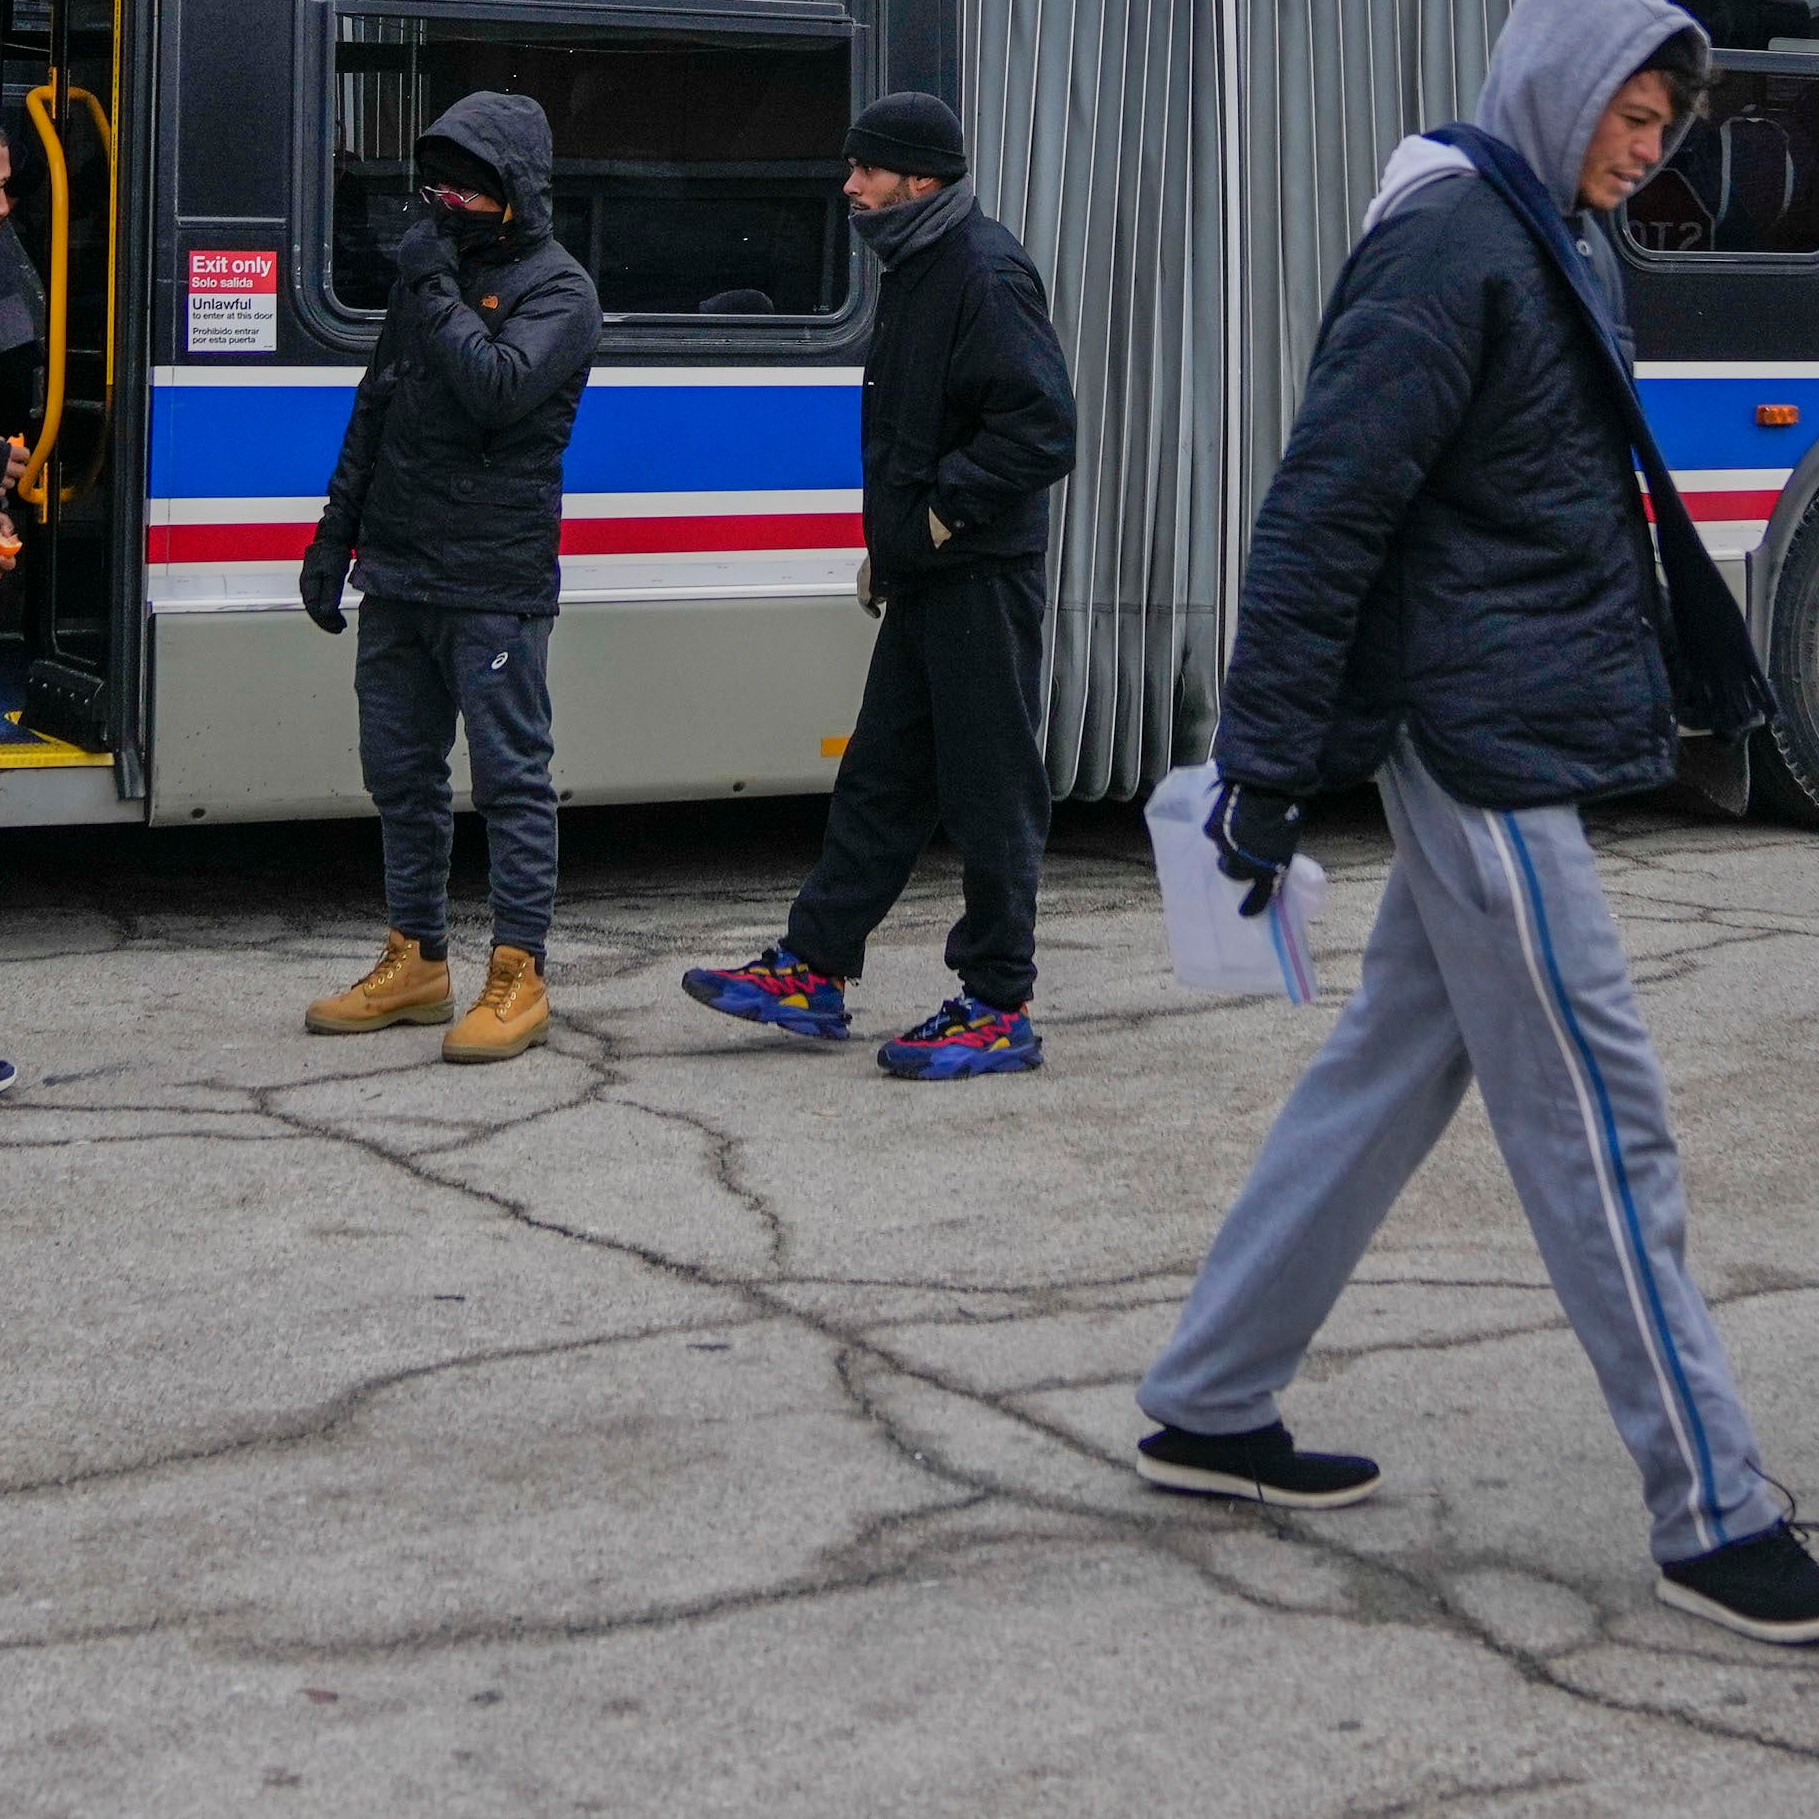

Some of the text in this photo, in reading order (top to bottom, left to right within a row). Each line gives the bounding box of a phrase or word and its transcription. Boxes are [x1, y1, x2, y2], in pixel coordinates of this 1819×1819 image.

[192, 255, 273, 277] Exit only
[191, 276, 254, 288] Solo salida
[192, 297, 252, 310] Unlawful
[192, 312, 201, 320] to
[237, 312, 252, 320] this
[254, 312, 273, 320] door
[192, 327, 233, 335] Prohibido
